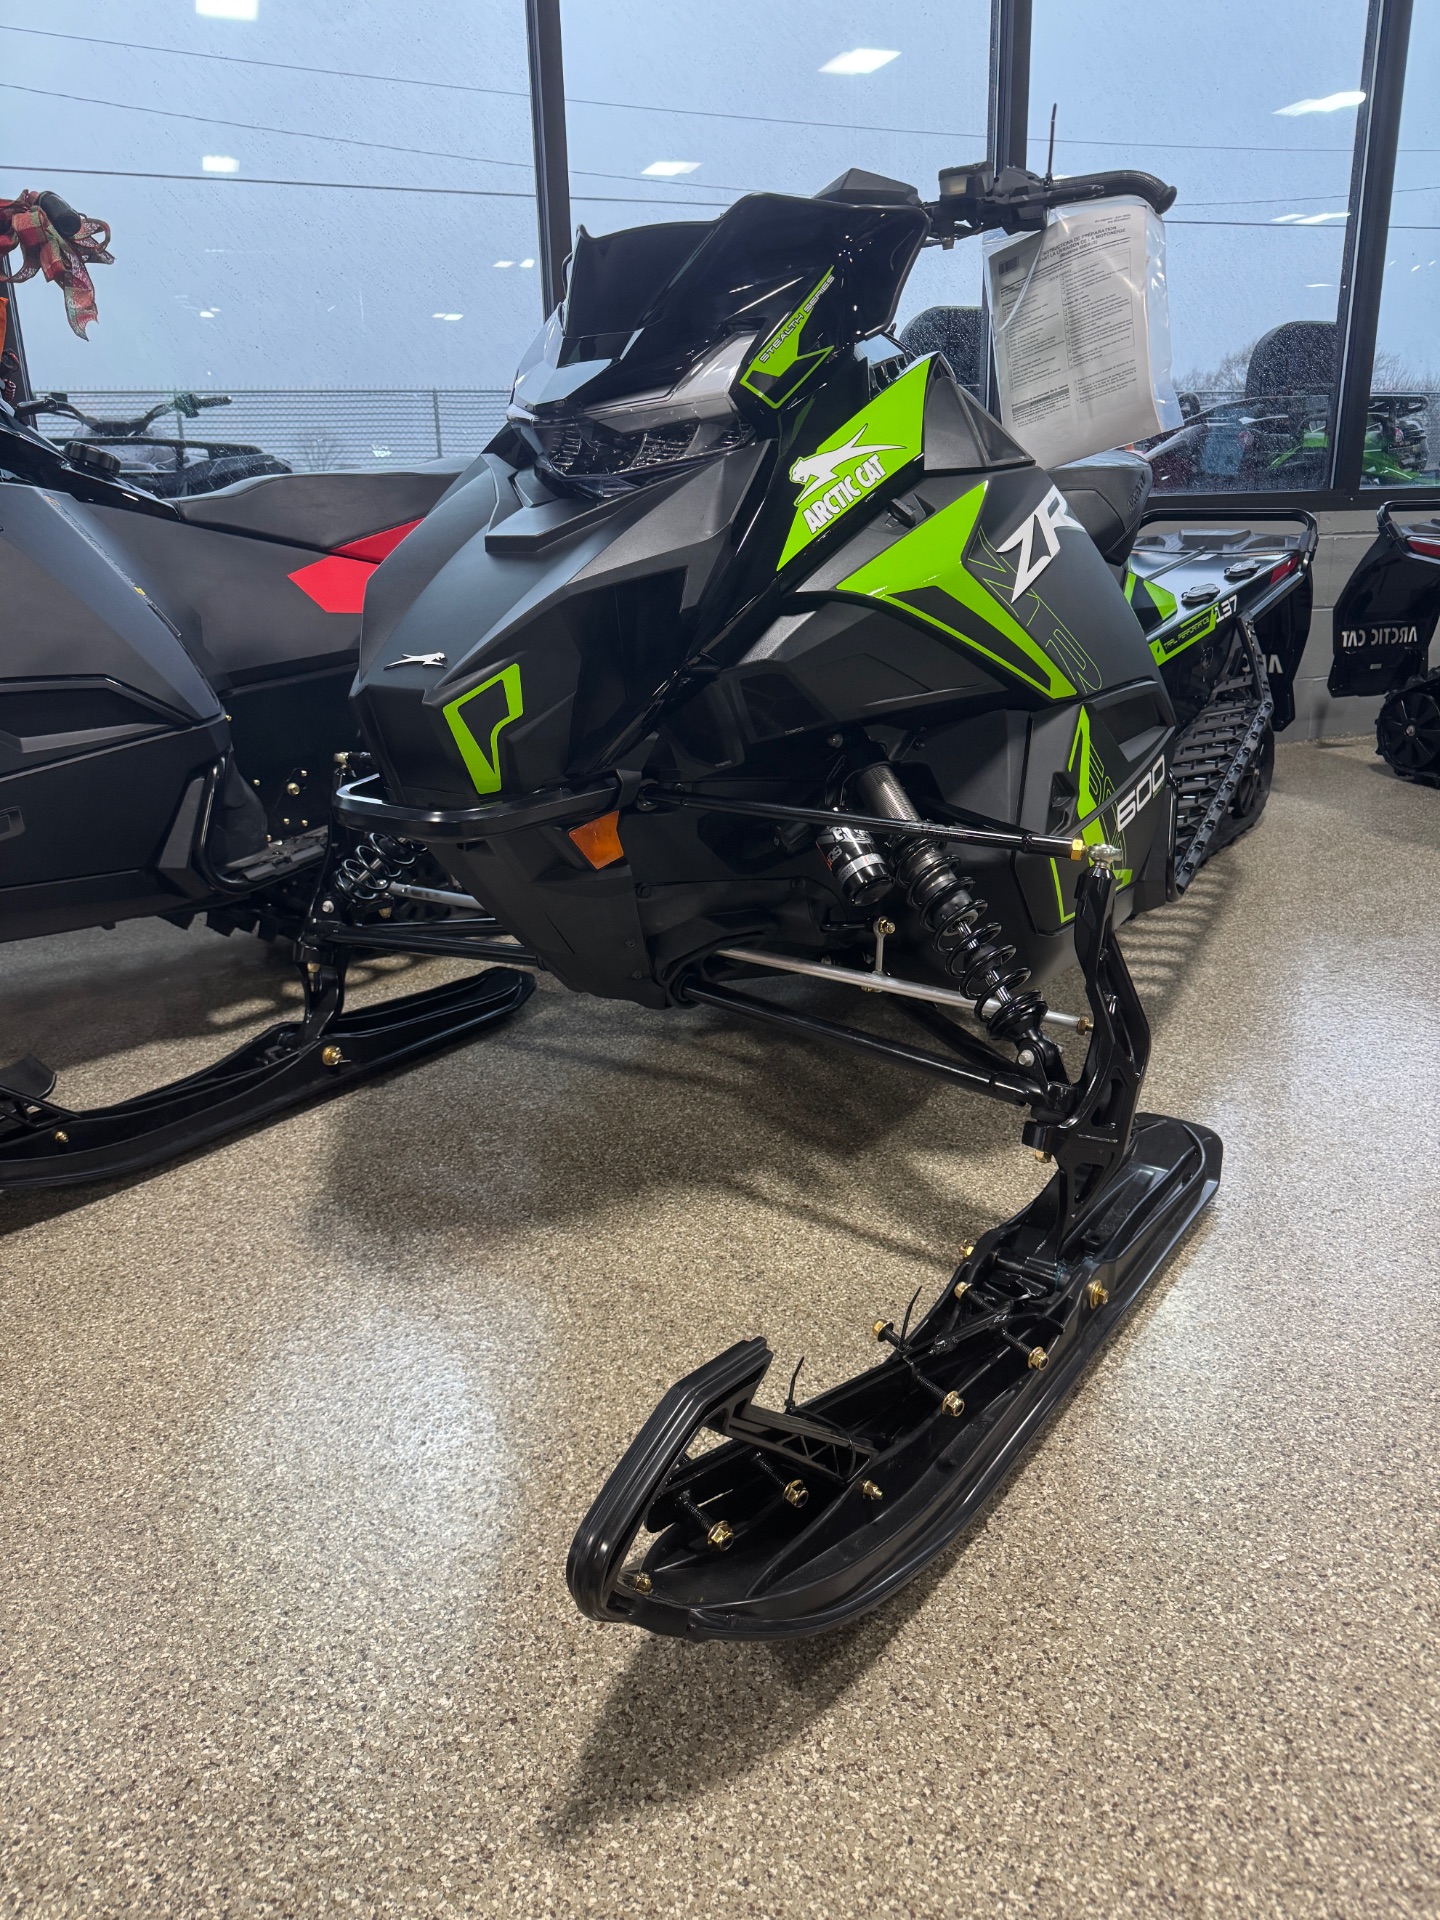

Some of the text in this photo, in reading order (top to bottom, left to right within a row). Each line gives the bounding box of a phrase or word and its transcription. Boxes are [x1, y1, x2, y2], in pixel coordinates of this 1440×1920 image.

[759, 274, 835, 363] STEALTH SERIES
[802, 453, 888, 535] ARCTIC CAT
[996, 484, 1086, 603] ZR
[1214, 594, 1238, 623] 137
[1117, 754, 1165, 832] 600
